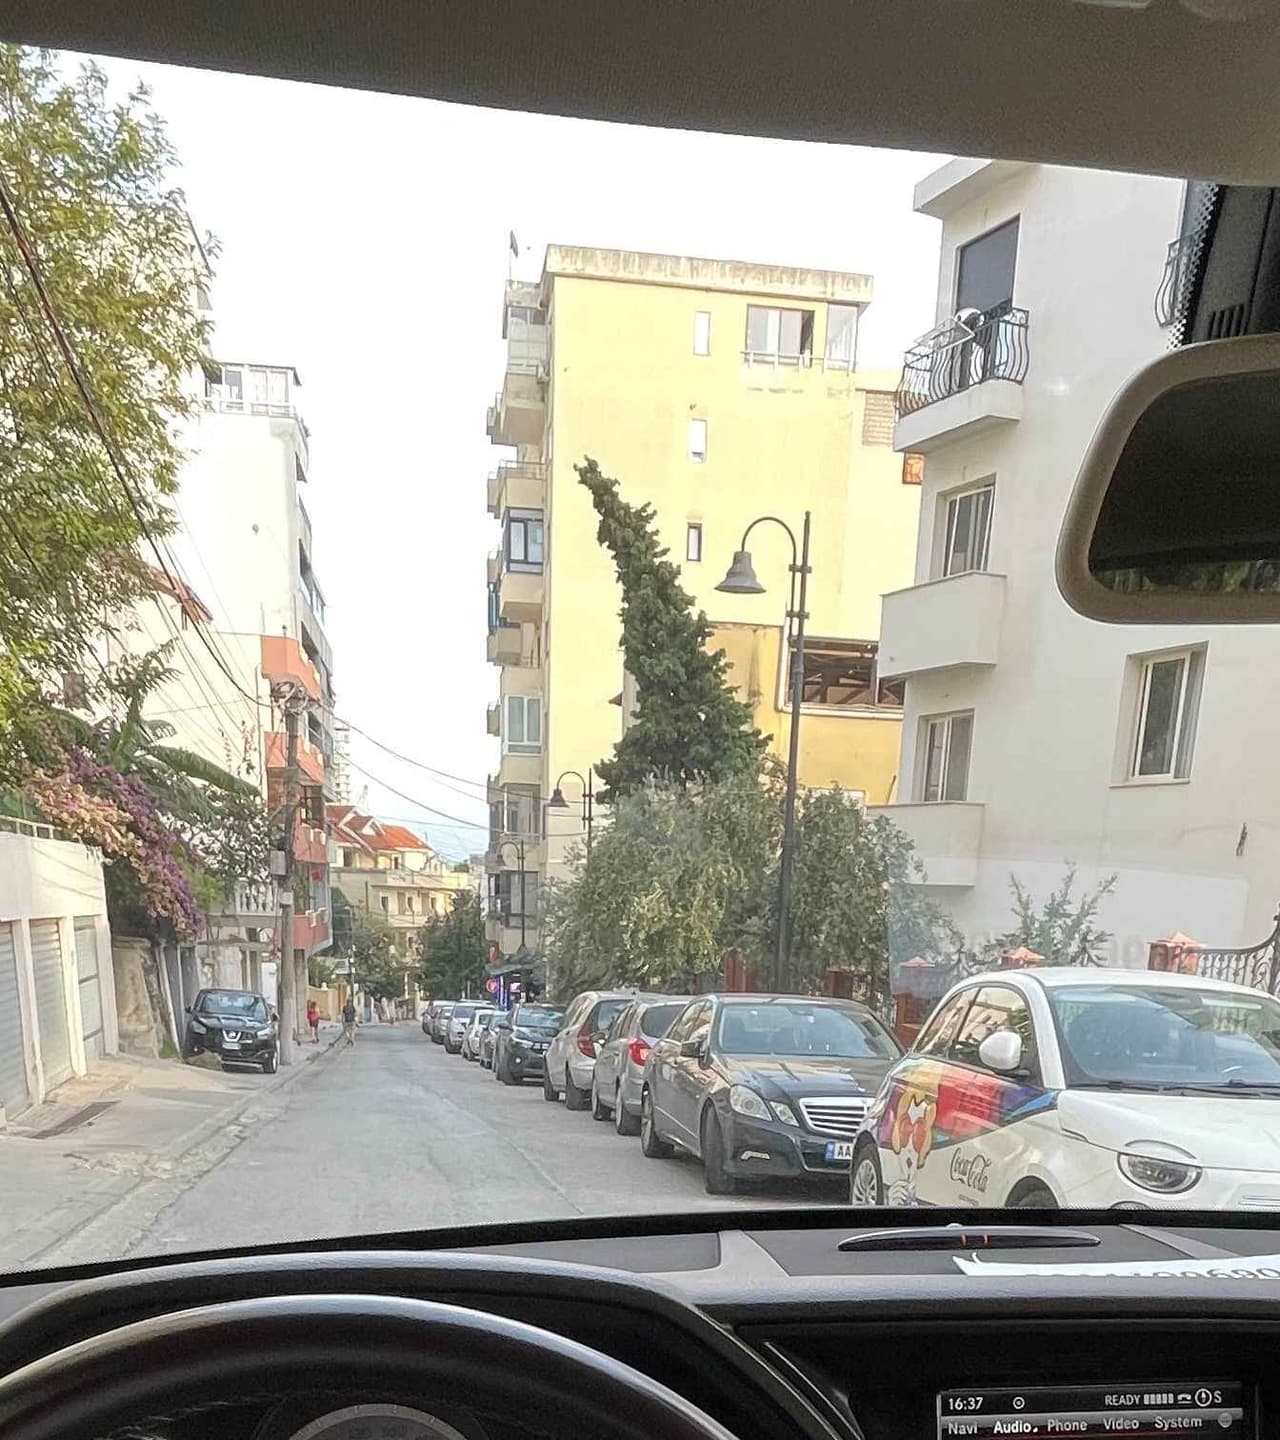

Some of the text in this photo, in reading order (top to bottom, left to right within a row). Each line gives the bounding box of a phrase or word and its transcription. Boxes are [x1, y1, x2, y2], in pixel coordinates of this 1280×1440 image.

[948, 1396, 983, 1411] 16:37
[1104, 1394, 1141, 1406] READY
[948, 1415, 1203, 1435] Navi Audio Phone Video System
